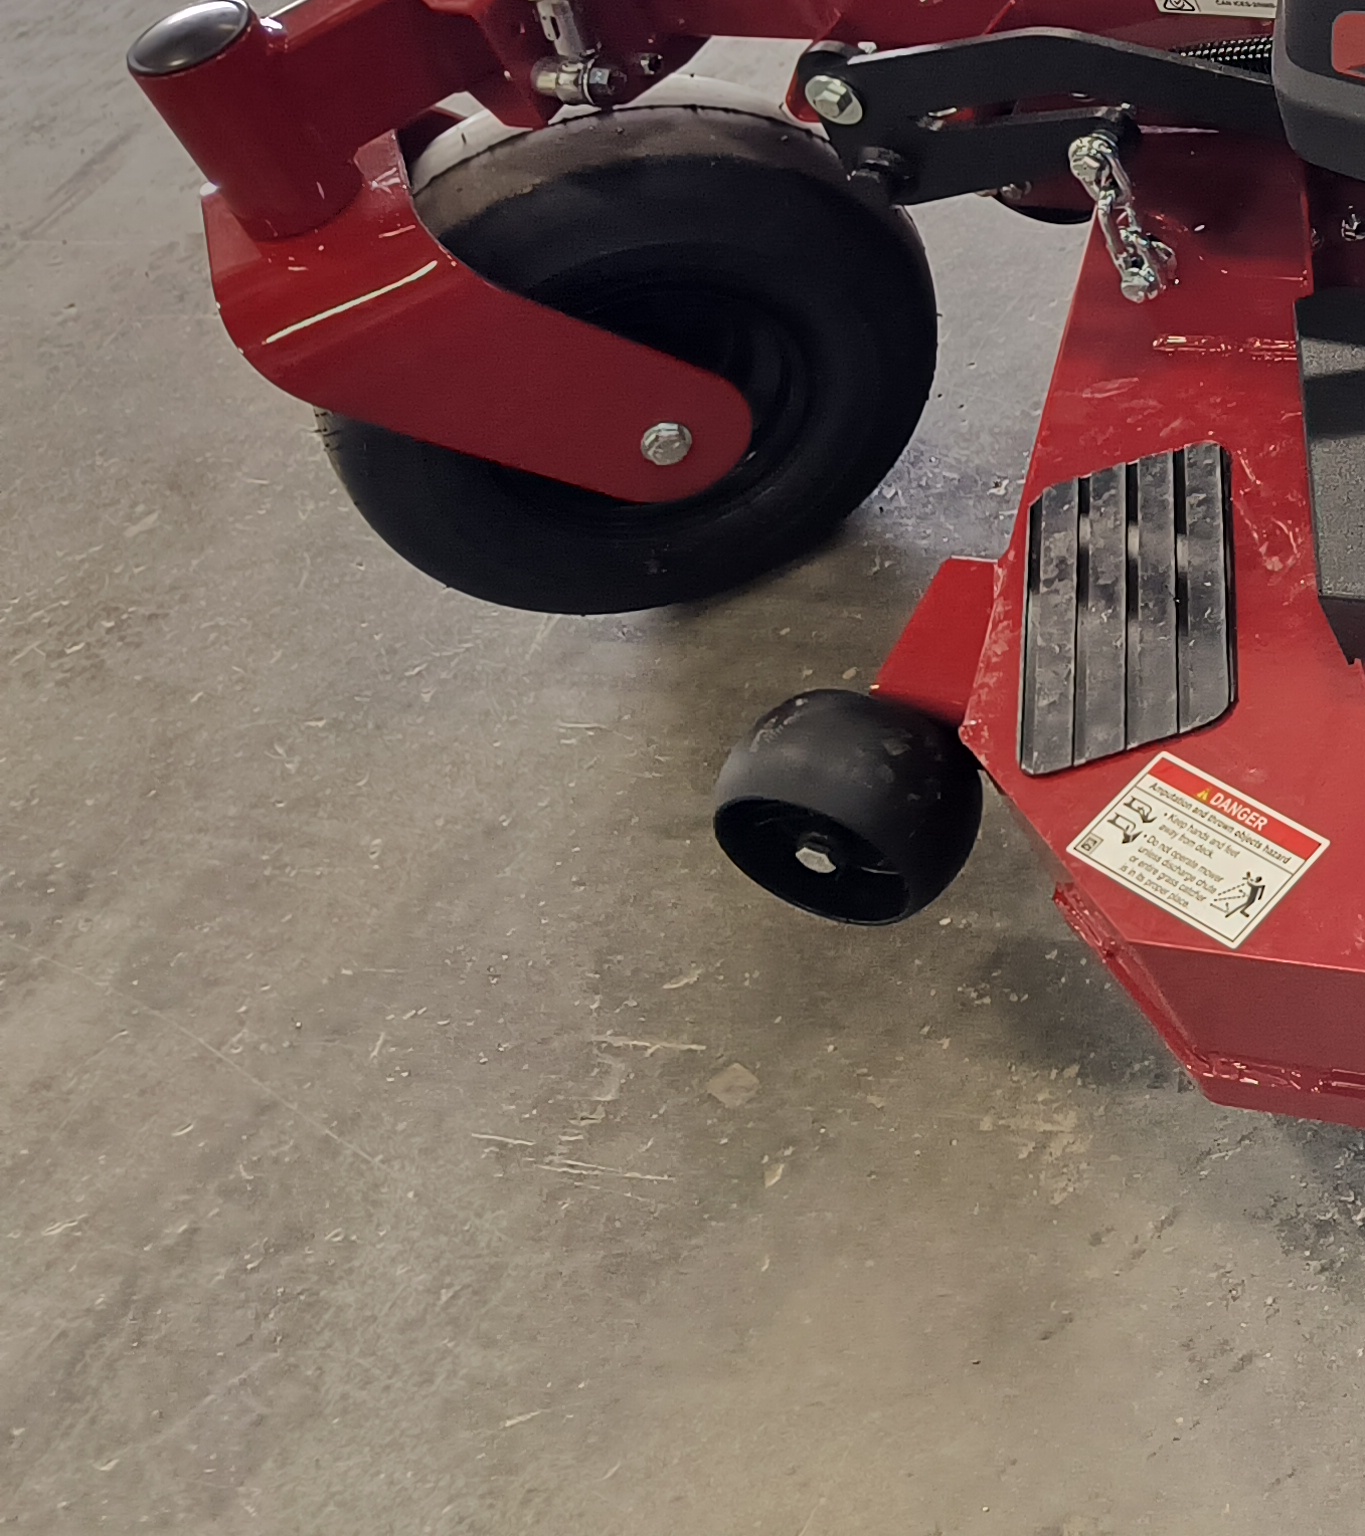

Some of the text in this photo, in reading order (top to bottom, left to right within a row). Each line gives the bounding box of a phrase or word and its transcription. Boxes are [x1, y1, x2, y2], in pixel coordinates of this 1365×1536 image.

[1147, 780, 1291, 865] Amputation and thrown objects hazard
[1165, 812, 1241, 858] Keep hands and feet
[1207, 791, 1270, 832] DANGER
[1145, 834, 1224, 883] Do not operate mower
[1156, 823, 1217, 859] away from deck.
[1118, 863, 1192, 909] is in its proper place.
[1127, 854, 1207, 903] or entire grass catcher
[1136, 844, 1218, 894] unless discharge chute
